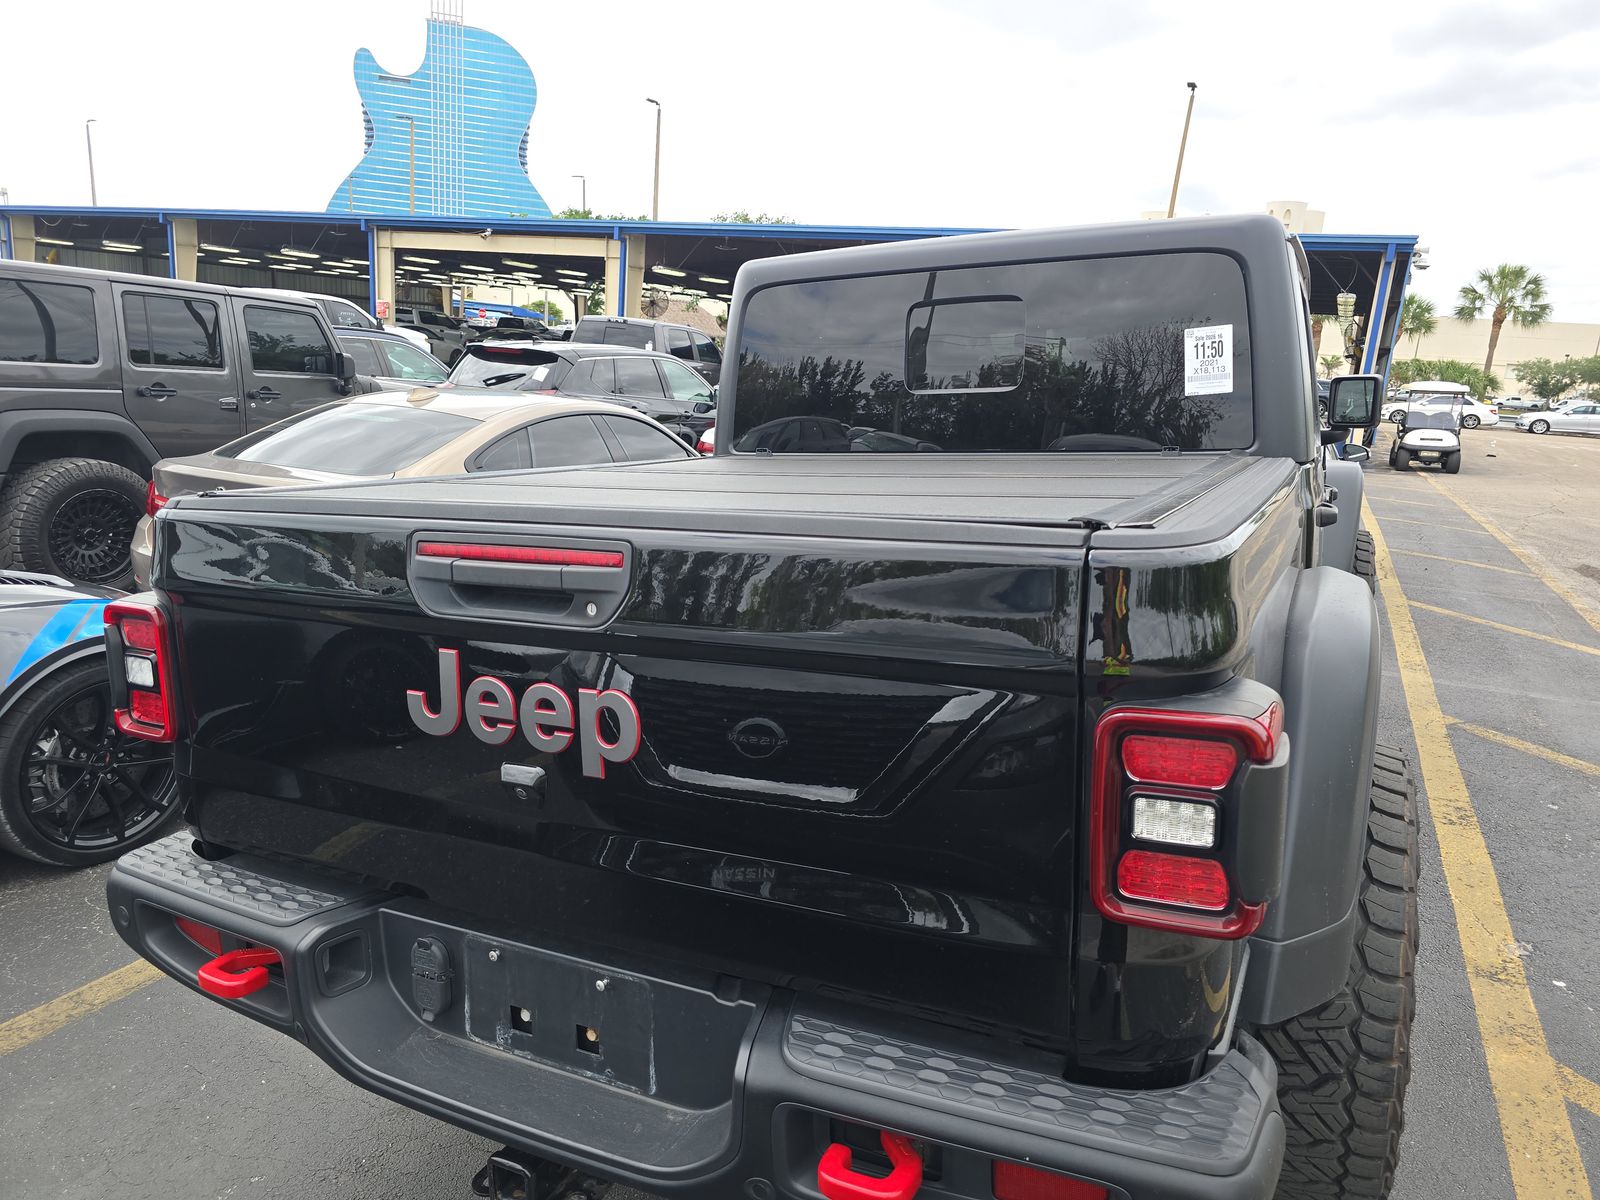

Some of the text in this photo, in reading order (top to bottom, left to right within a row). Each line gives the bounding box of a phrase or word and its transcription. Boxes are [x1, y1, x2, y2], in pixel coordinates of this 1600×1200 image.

[1194, 340, 1224, 360] 11:50
[1200, 359, 1219, 367] 2021
[1193, 366, 1226, 375] X18,113
[406, 648, 642, 780] Jeep
